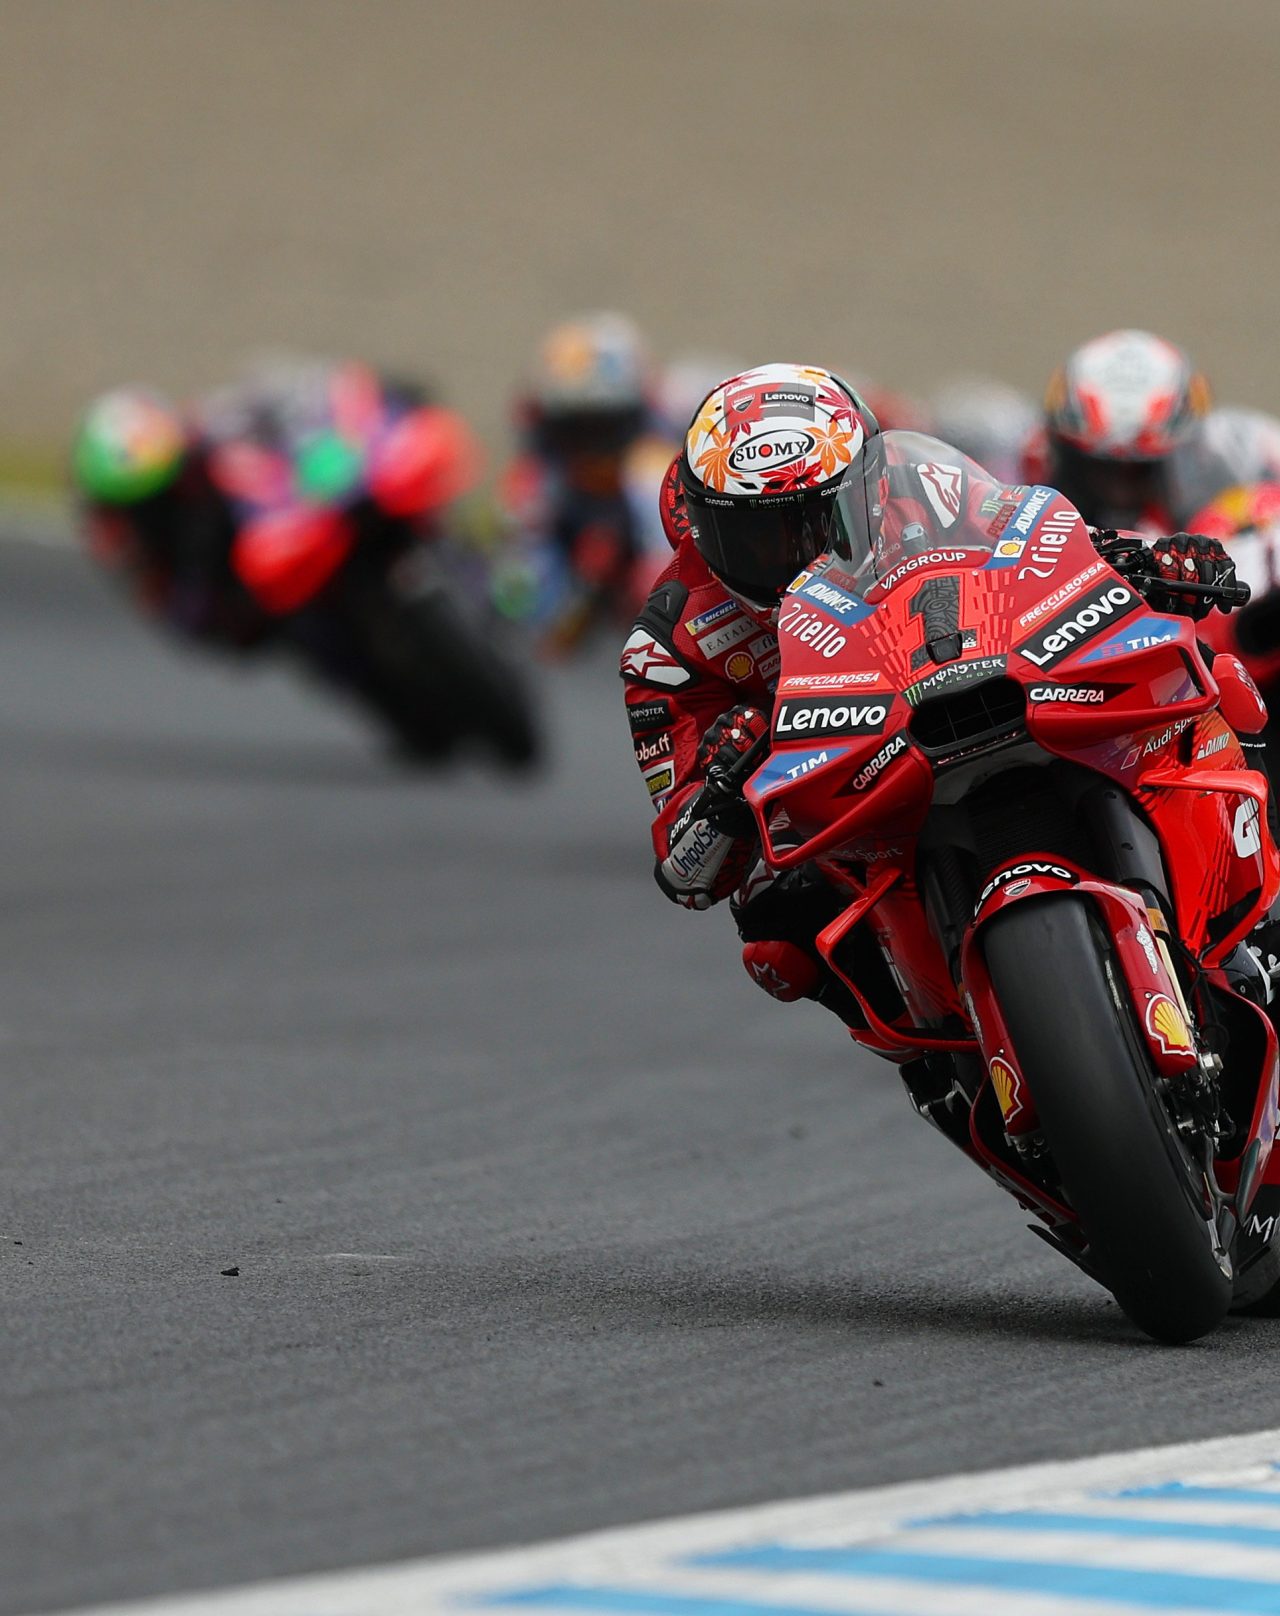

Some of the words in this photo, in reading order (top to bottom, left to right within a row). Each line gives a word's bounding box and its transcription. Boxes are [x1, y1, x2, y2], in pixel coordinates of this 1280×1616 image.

[765, 393, 810, 403] Lenovo
[735, 441, 807, 462] SUOMY
[881, 552, 967, 590] VARGROUP
[802, 583, 858, 614] ADVANCE
[1019, 562, 1106, 627] FRECCIAROSSA
[705, 602, 737, 622] MICHELI
[910, 575, 977, 672] 1
[1021, 587, 1131, 666] Lenovo
[706, 618, 755, 651] EATALY
[1127, 634, 1173, 650] TIM
[783, 672, 881, 688] FRECCIAROSSA
[922, 658, 1006, 690] MONSTER
[936, 671, 994, 690] ENERGY
[1030, 687, 1104, 702] CARRERA
[631, 706, 665, 718] MONSTER
[776, 706, 887, 732] Lenovo
[1142, 727, 1173, 757] Audi
[787, 751, 828, 779] TIM
[853, 736, 907, 790] CARRERA
[670, 821, 720, 878] UnipolSa
[974, 863, 1072, 918] Lenovo
